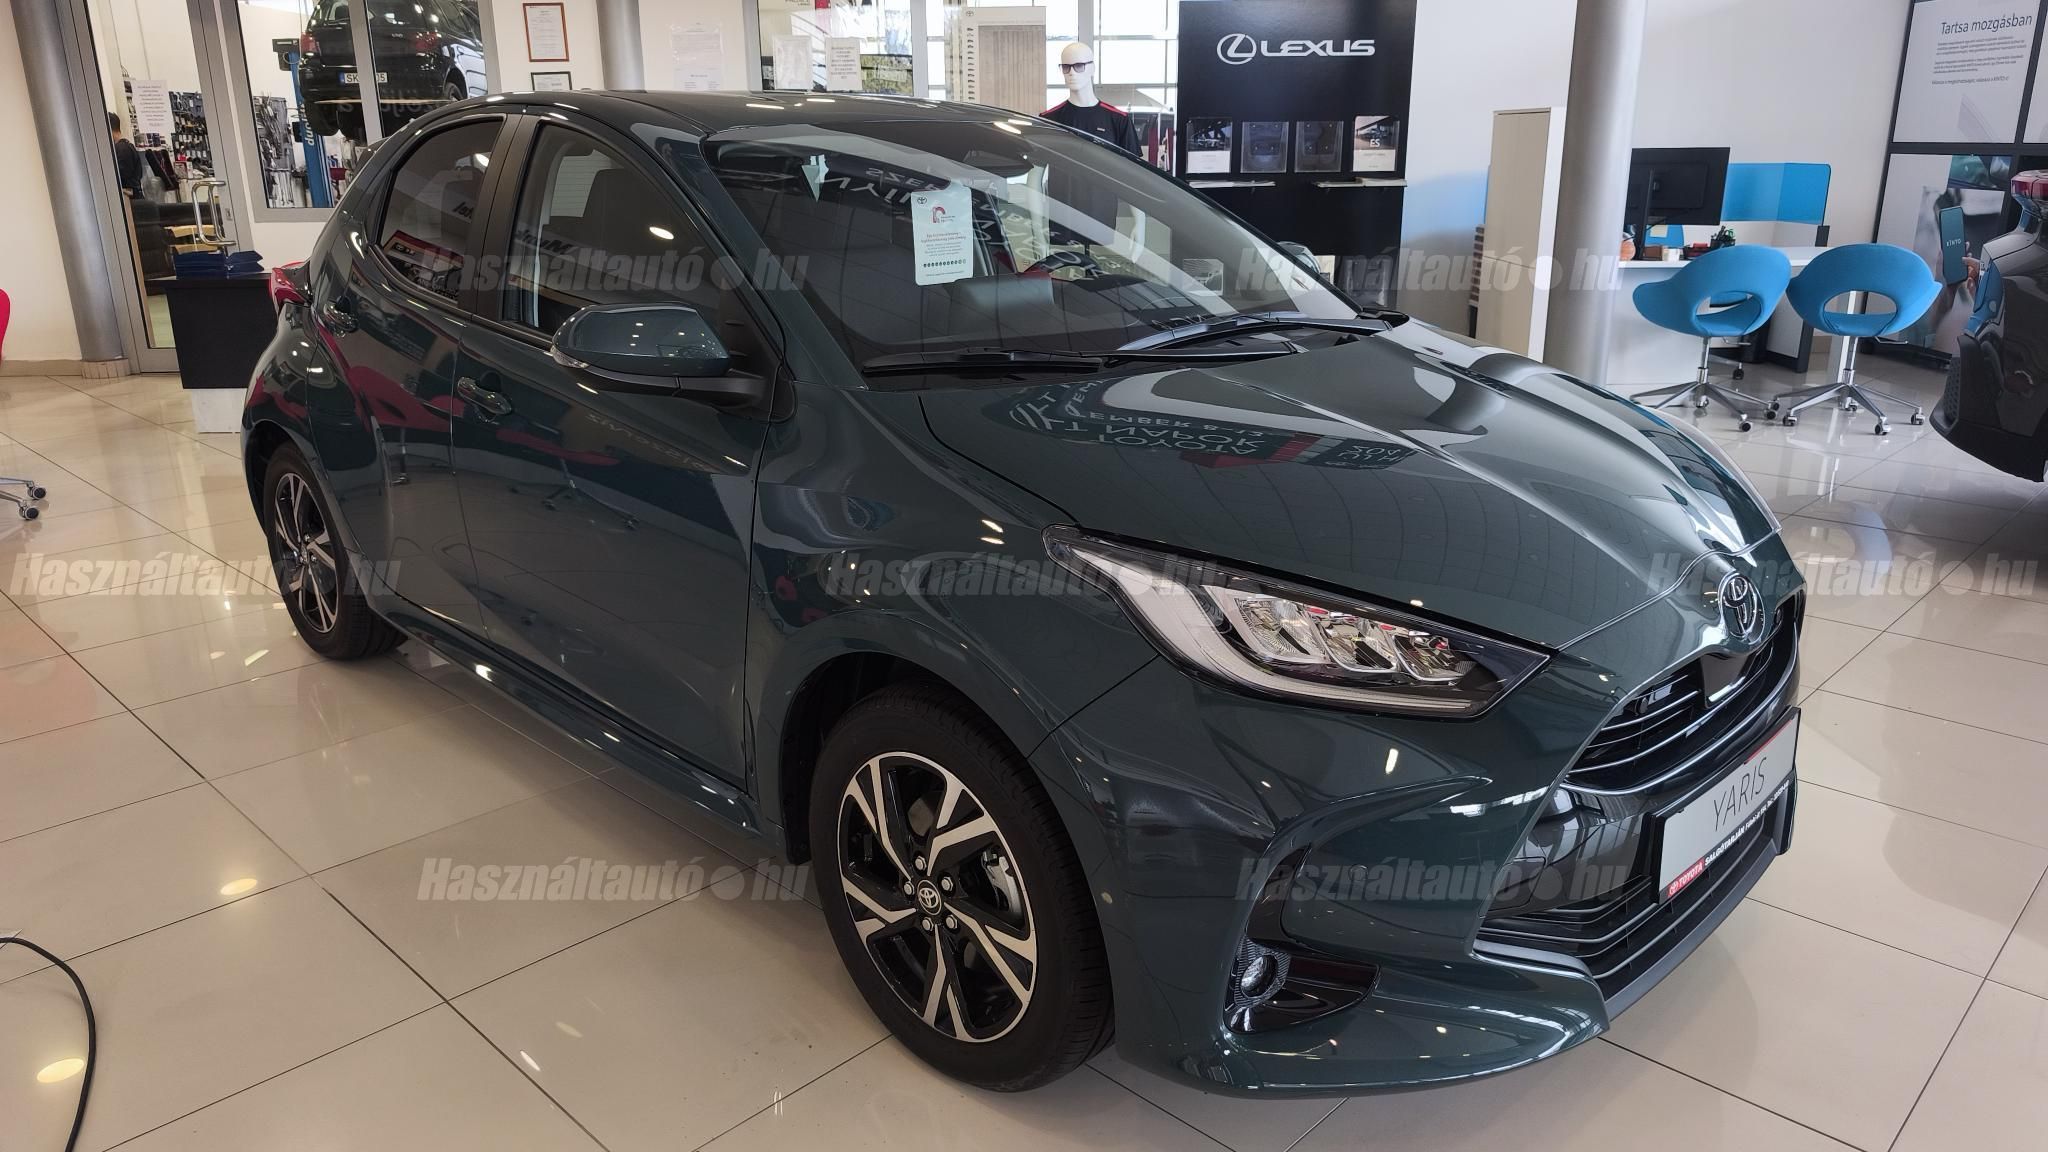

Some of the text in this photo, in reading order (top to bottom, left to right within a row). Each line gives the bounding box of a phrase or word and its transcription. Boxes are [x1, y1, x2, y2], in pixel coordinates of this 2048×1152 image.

[1941, 12, 2033, 35] Tartsa mozgásban
[1260, 39, 1376, 57] LEXUS
[1369, 138, 1381, 148] ES
[1713, 756, 1768, 831] YARIS
[1679, 862, 1703, 887] TOYOTA
